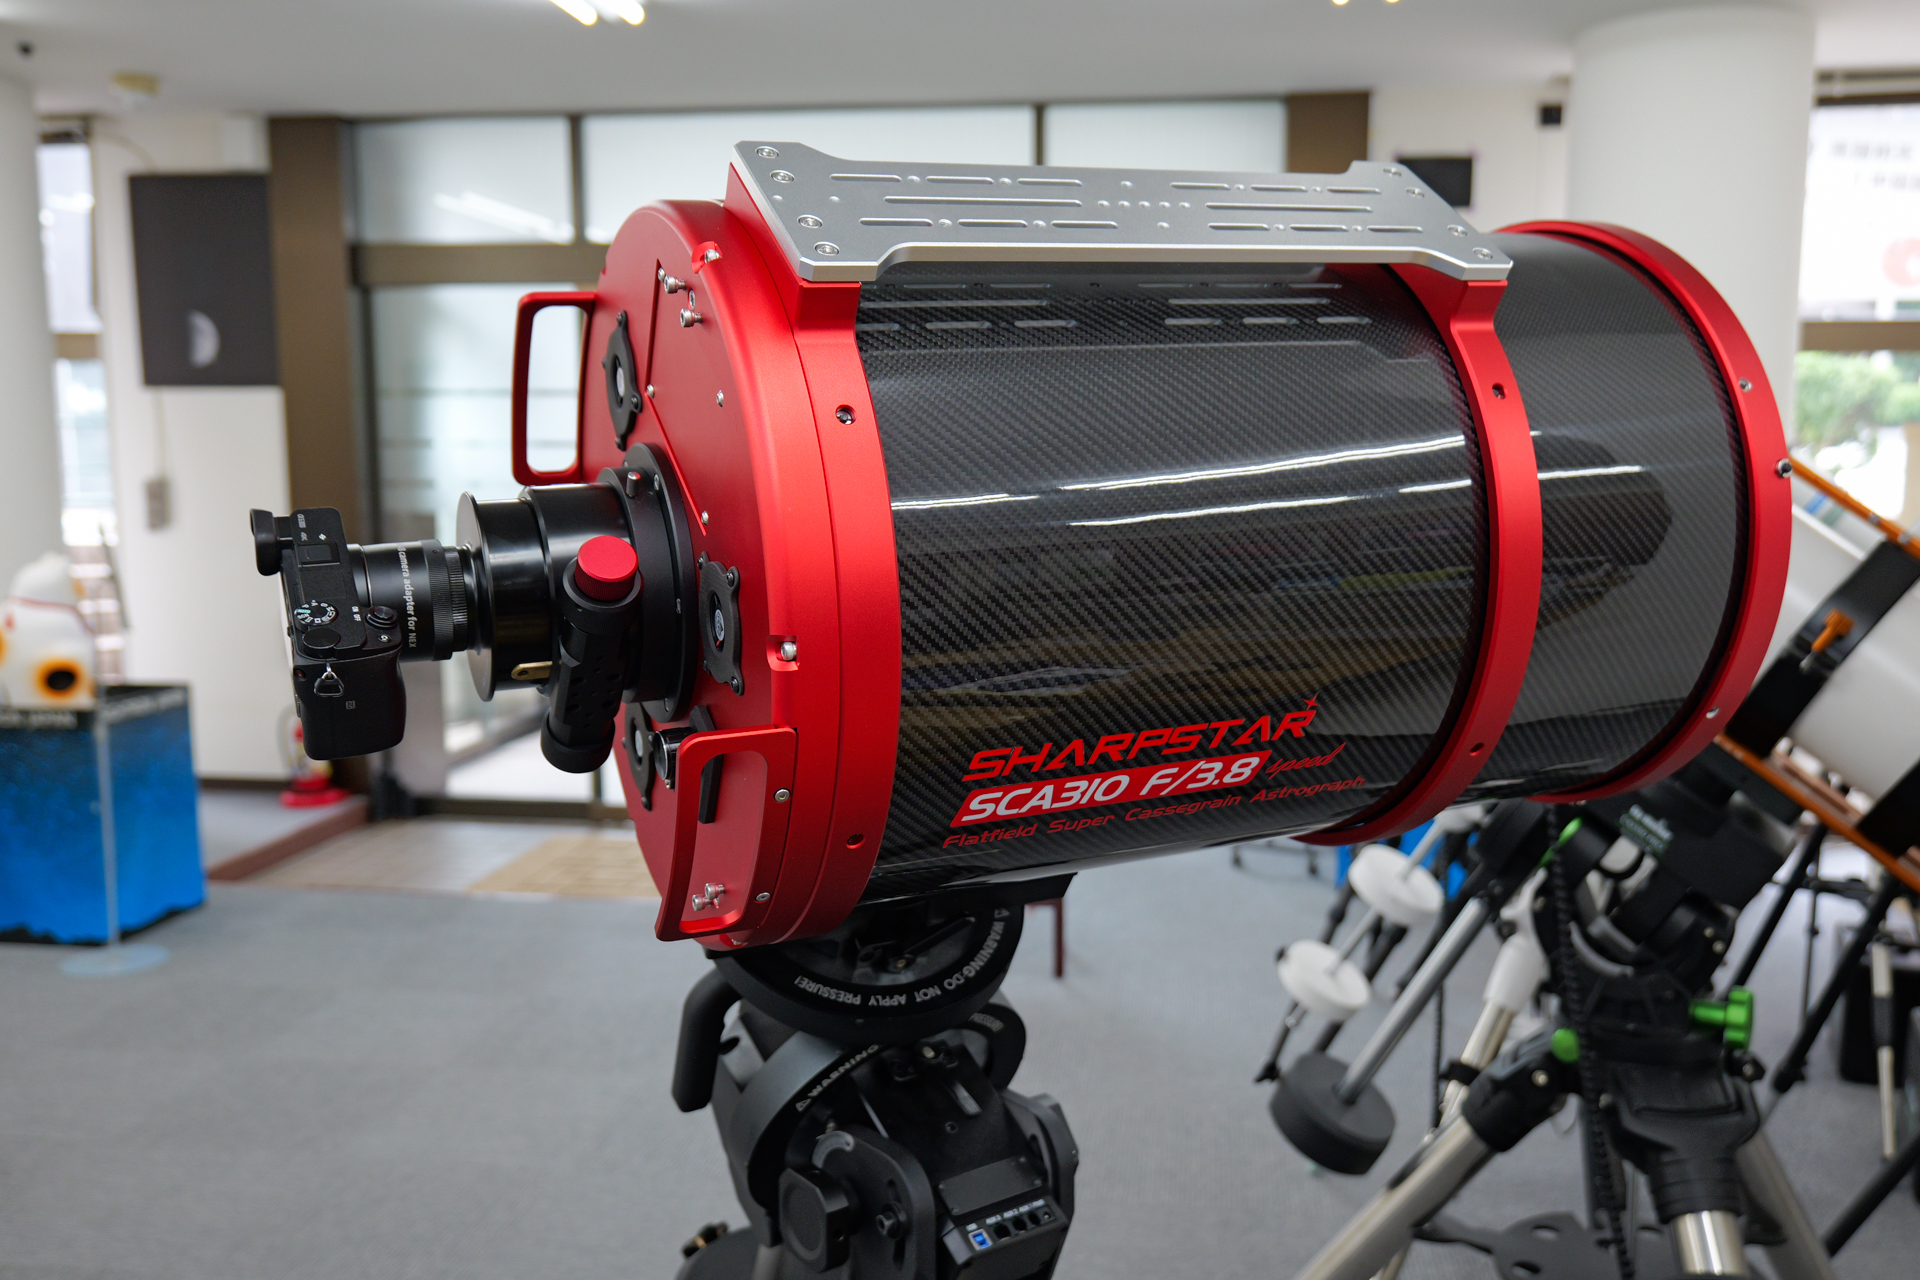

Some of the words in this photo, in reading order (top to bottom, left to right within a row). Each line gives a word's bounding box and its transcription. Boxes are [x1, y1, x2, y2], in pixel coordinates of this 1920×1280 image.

[399, 552, 410, 577] camera
[403, 579, 414, 615] adapter
[408, 616, 417, 630] for
[408, 633, 417, 648] NEX
[962, 708, 1317, 782] SHARPSTAR
[961, 774, 1130, 822] SCA310
[1139, 756, 1261, 796] F/3.8
[1265, 743, 1347, 780] speed
[942, 824, 1036, 849] Flatfield
[1046, 813, 1115, 834] Super
[1124, 794, 1241, 822] Cassegrain
[1249, 775, 1365, 804] Astrograph
[793, 975, 862, 1005] PRESSURE!
[868, 993, 907, 1006] APPLY
[913, 985, 941, 1003] NOT
